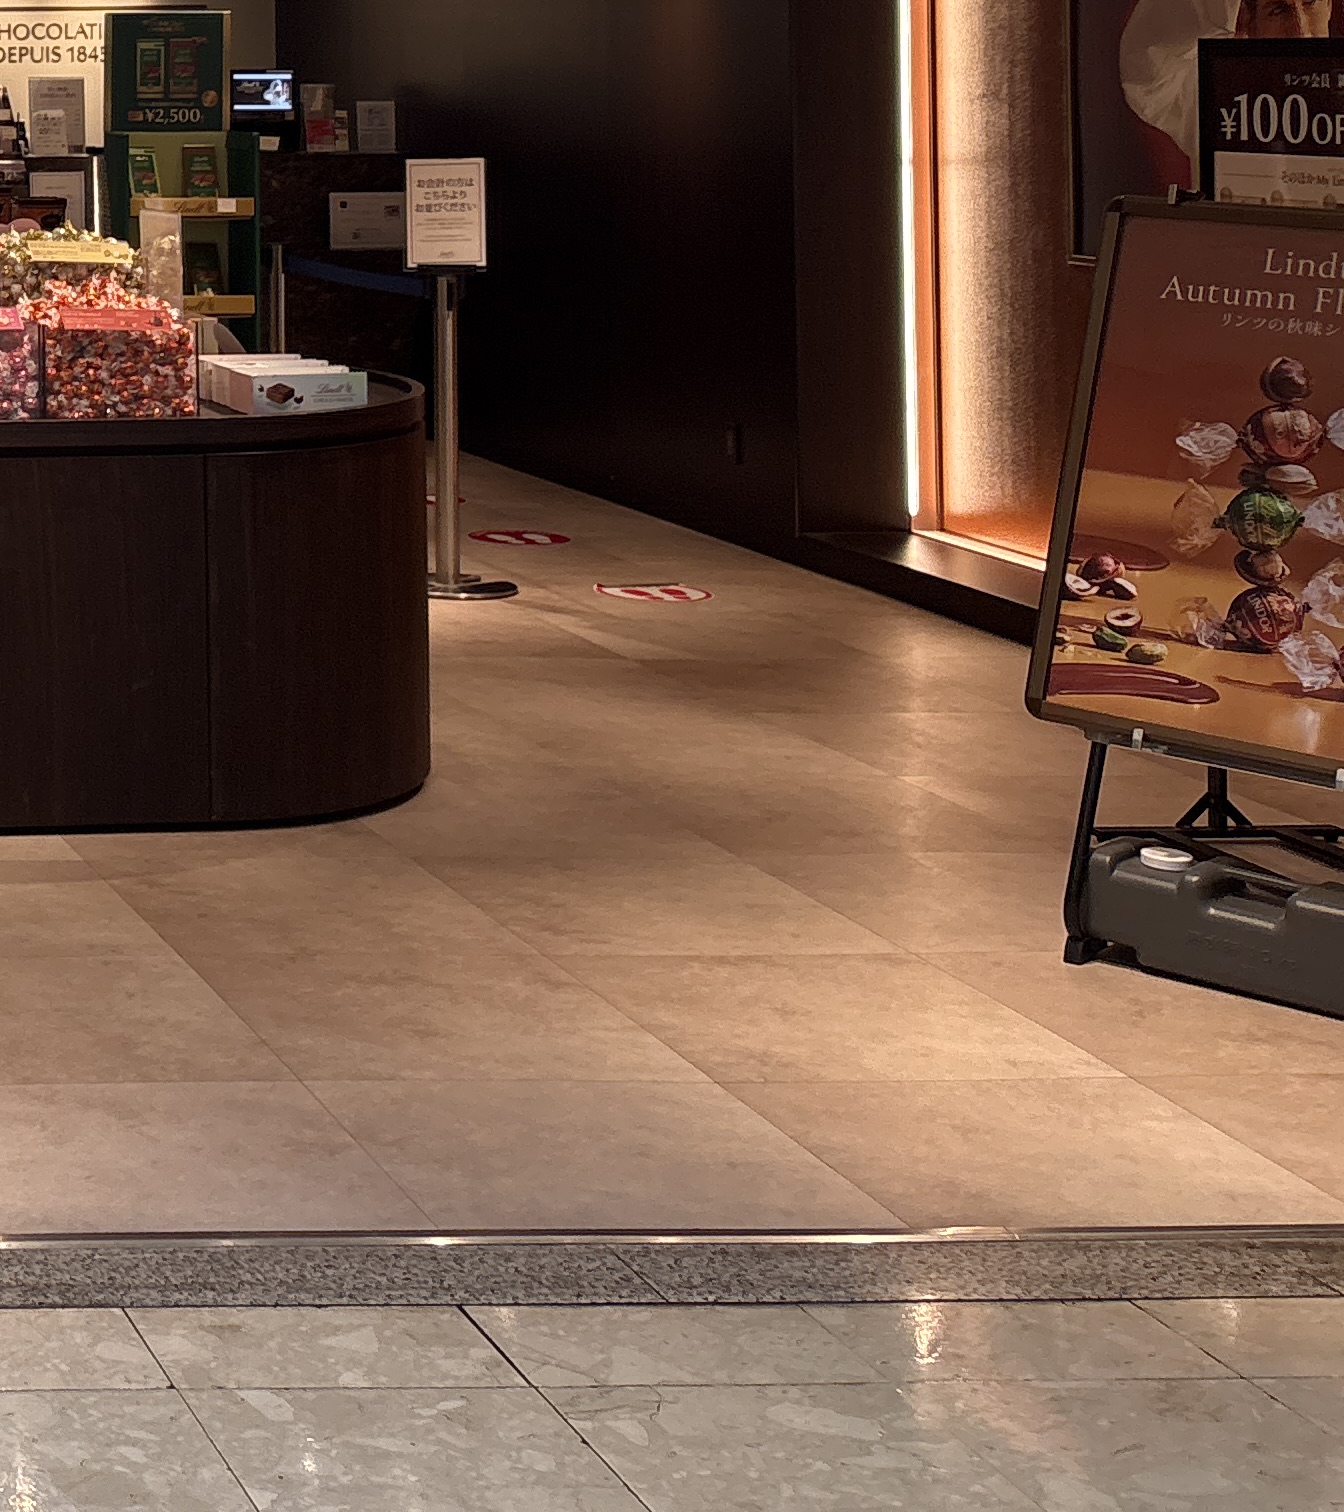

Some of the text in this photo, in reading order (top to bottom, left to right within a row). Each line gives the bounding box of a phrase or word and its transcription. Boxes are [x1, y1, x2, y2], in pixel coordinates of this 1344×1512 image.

[145, 108, 201, 124] ¥2,500
[1220, 93, 1309, 144] ¥100
[424, 190, 467, 200] こちらより
[1160, 275, 1296, 311] Autumn
